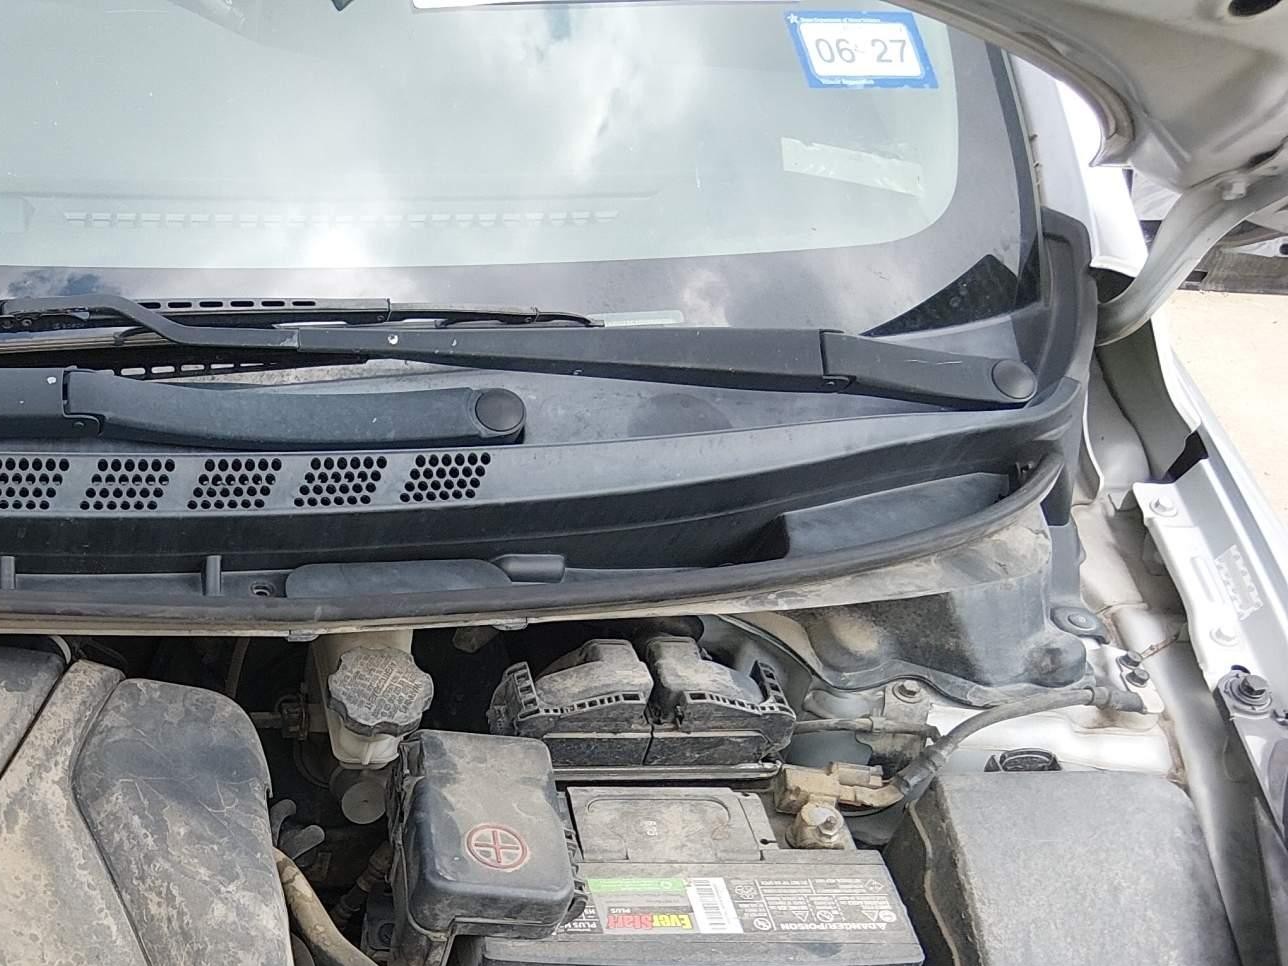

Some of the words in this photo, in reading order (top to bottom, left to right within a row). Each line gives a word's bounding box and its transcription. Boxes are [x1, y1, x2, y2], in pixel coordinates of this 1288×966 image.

[815, 38, 855, 63] 06
[870, 38, 906, 63] 27
[572, 921, 597, 929] PLUS
[606, 912, 693, 930] EverStart
[780, 922, 881, 930] DANGER/POISON
